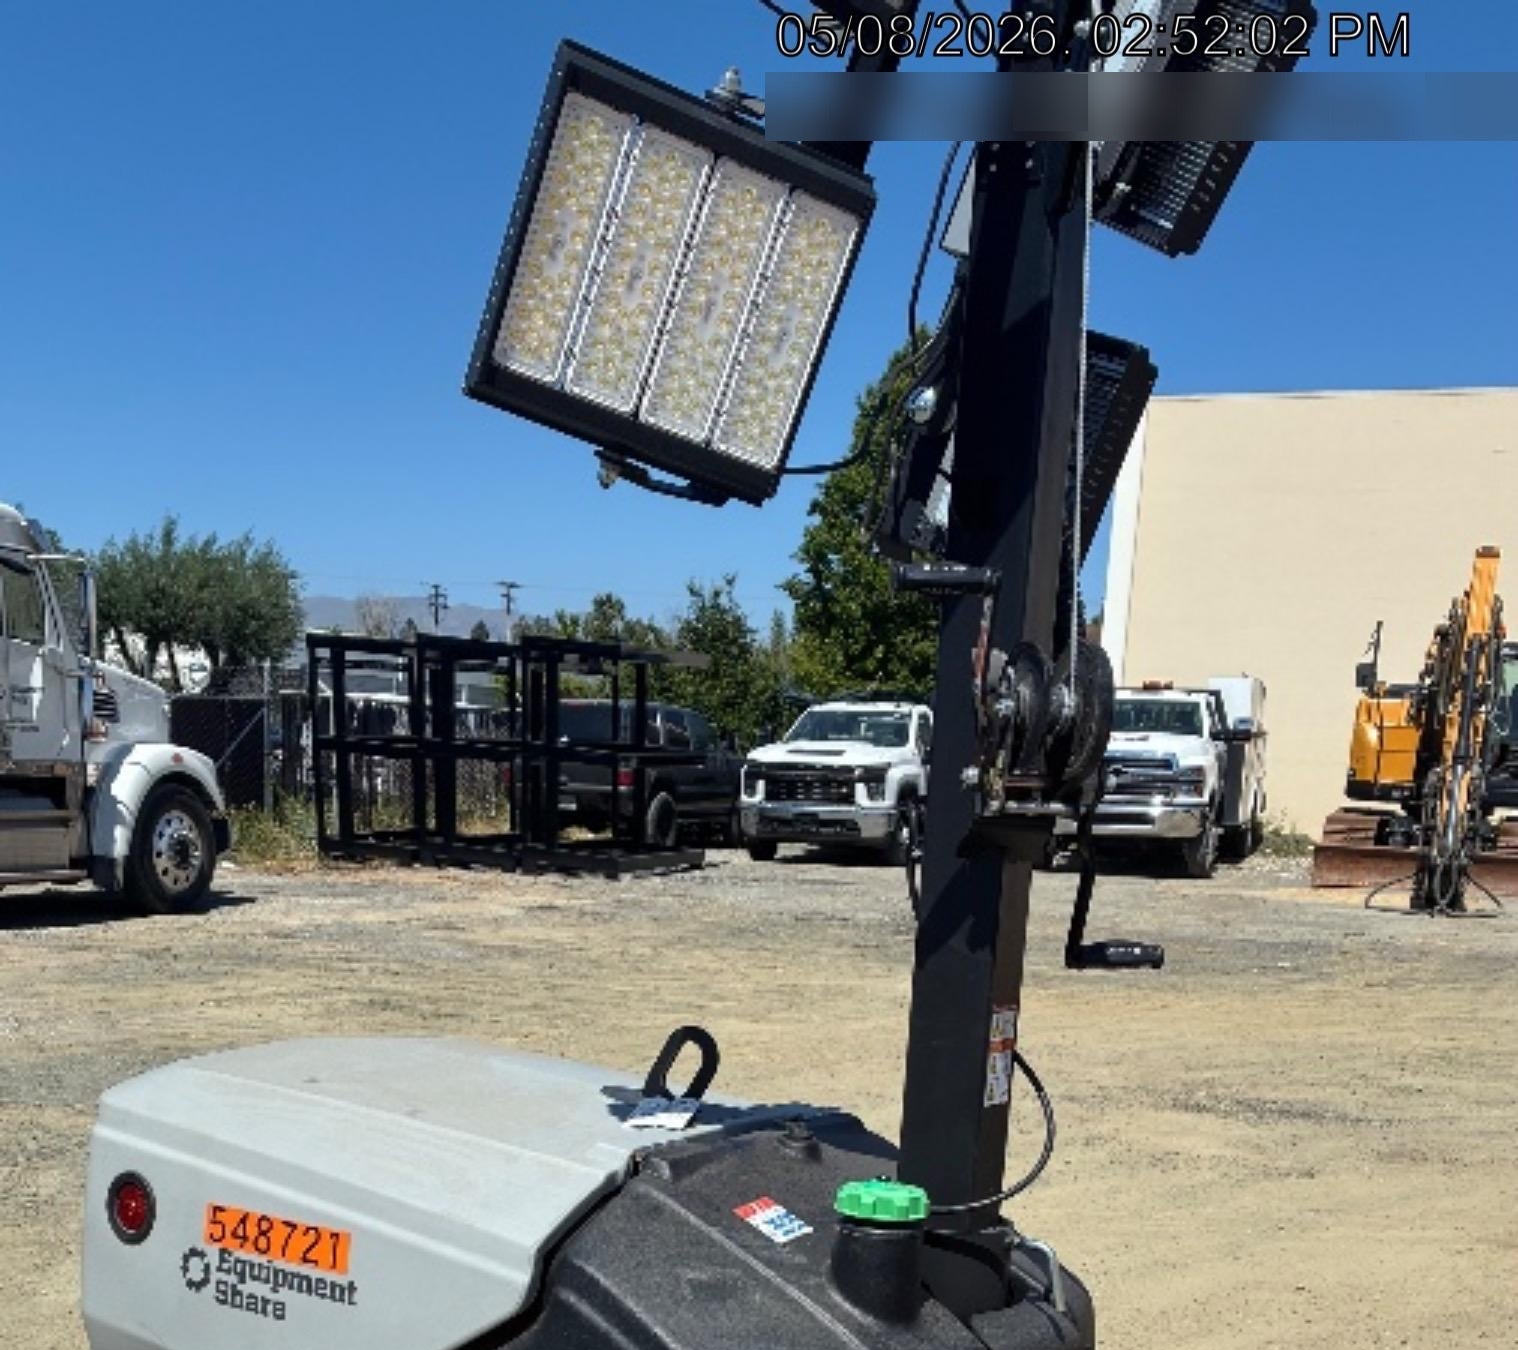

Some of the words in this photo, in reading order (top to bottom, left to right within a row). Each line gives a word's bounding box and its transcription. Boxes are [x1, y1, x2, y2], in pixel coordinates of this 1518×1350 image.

[208, 1204, 341, 1270] 548721
[215, 1279, 286, 1321] Share
[216, 1247, 358, 1306] Equipment
